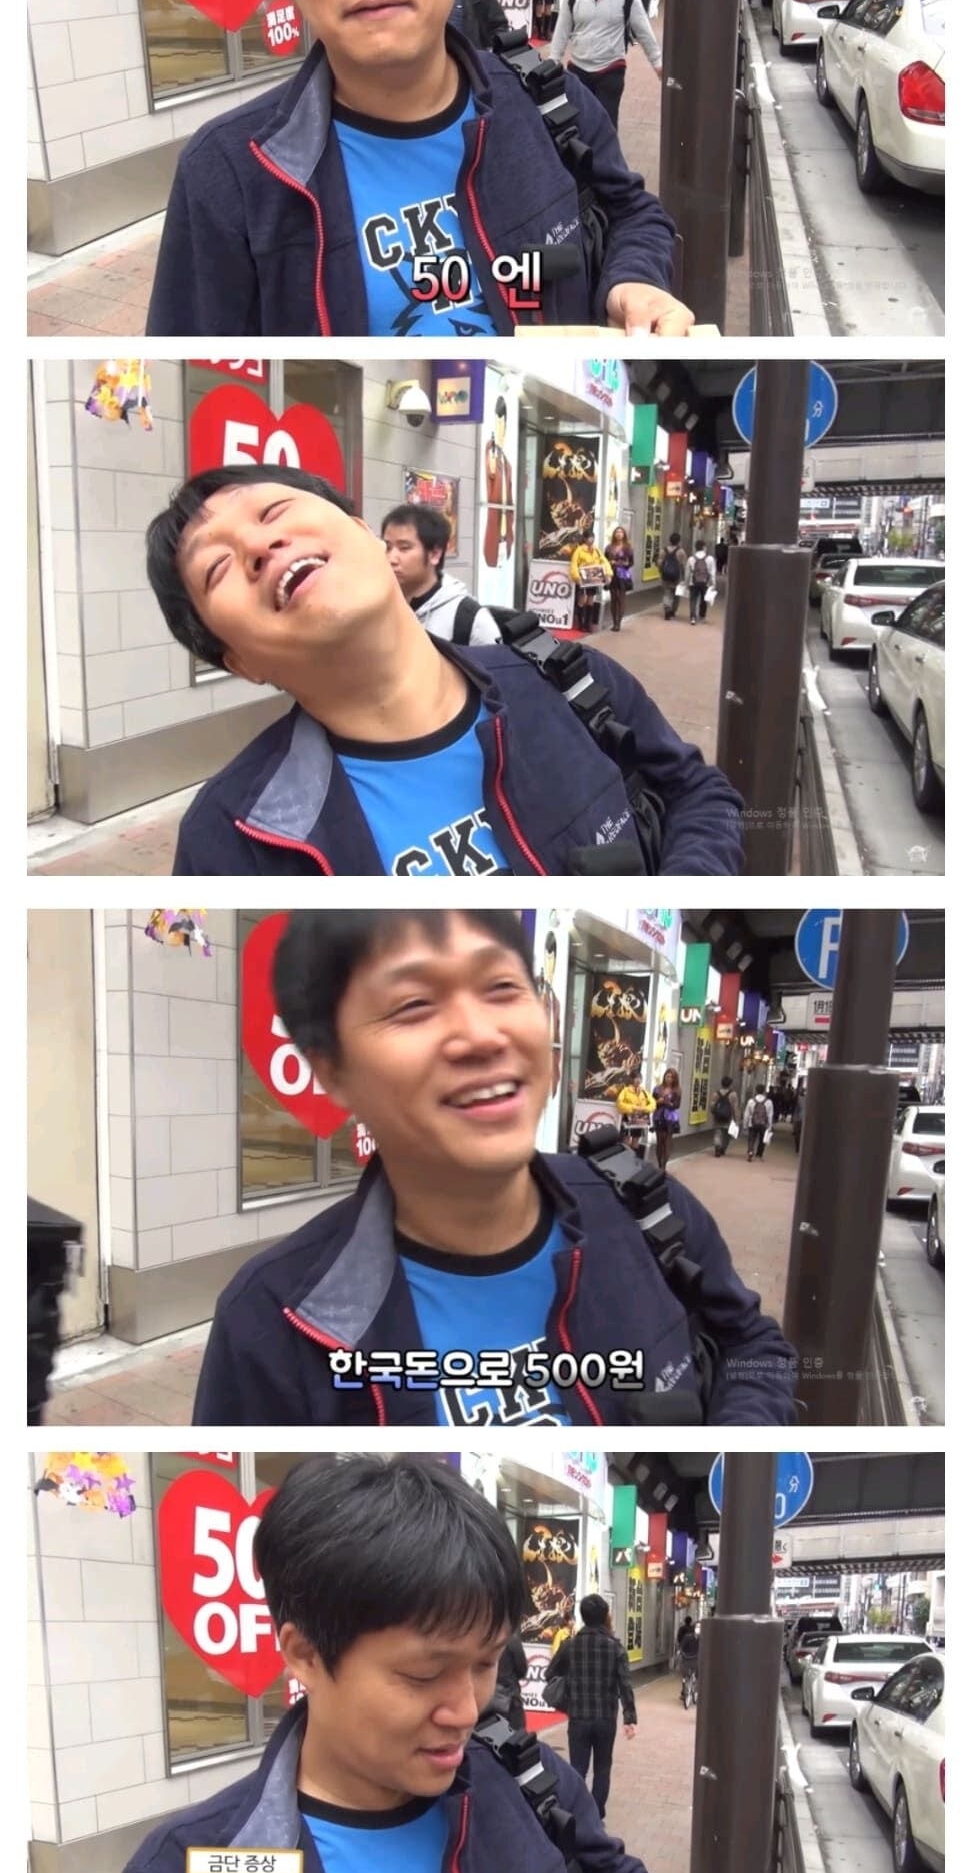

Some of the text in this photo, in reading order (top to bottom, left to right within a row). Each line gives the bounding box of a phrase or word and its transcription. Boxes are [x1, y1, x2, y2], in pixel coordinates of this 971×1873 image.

[267, 23, 299, 47] 100%
[530, 582, 570, 599] UNO
[193, 1602, 281, 1655] OF
